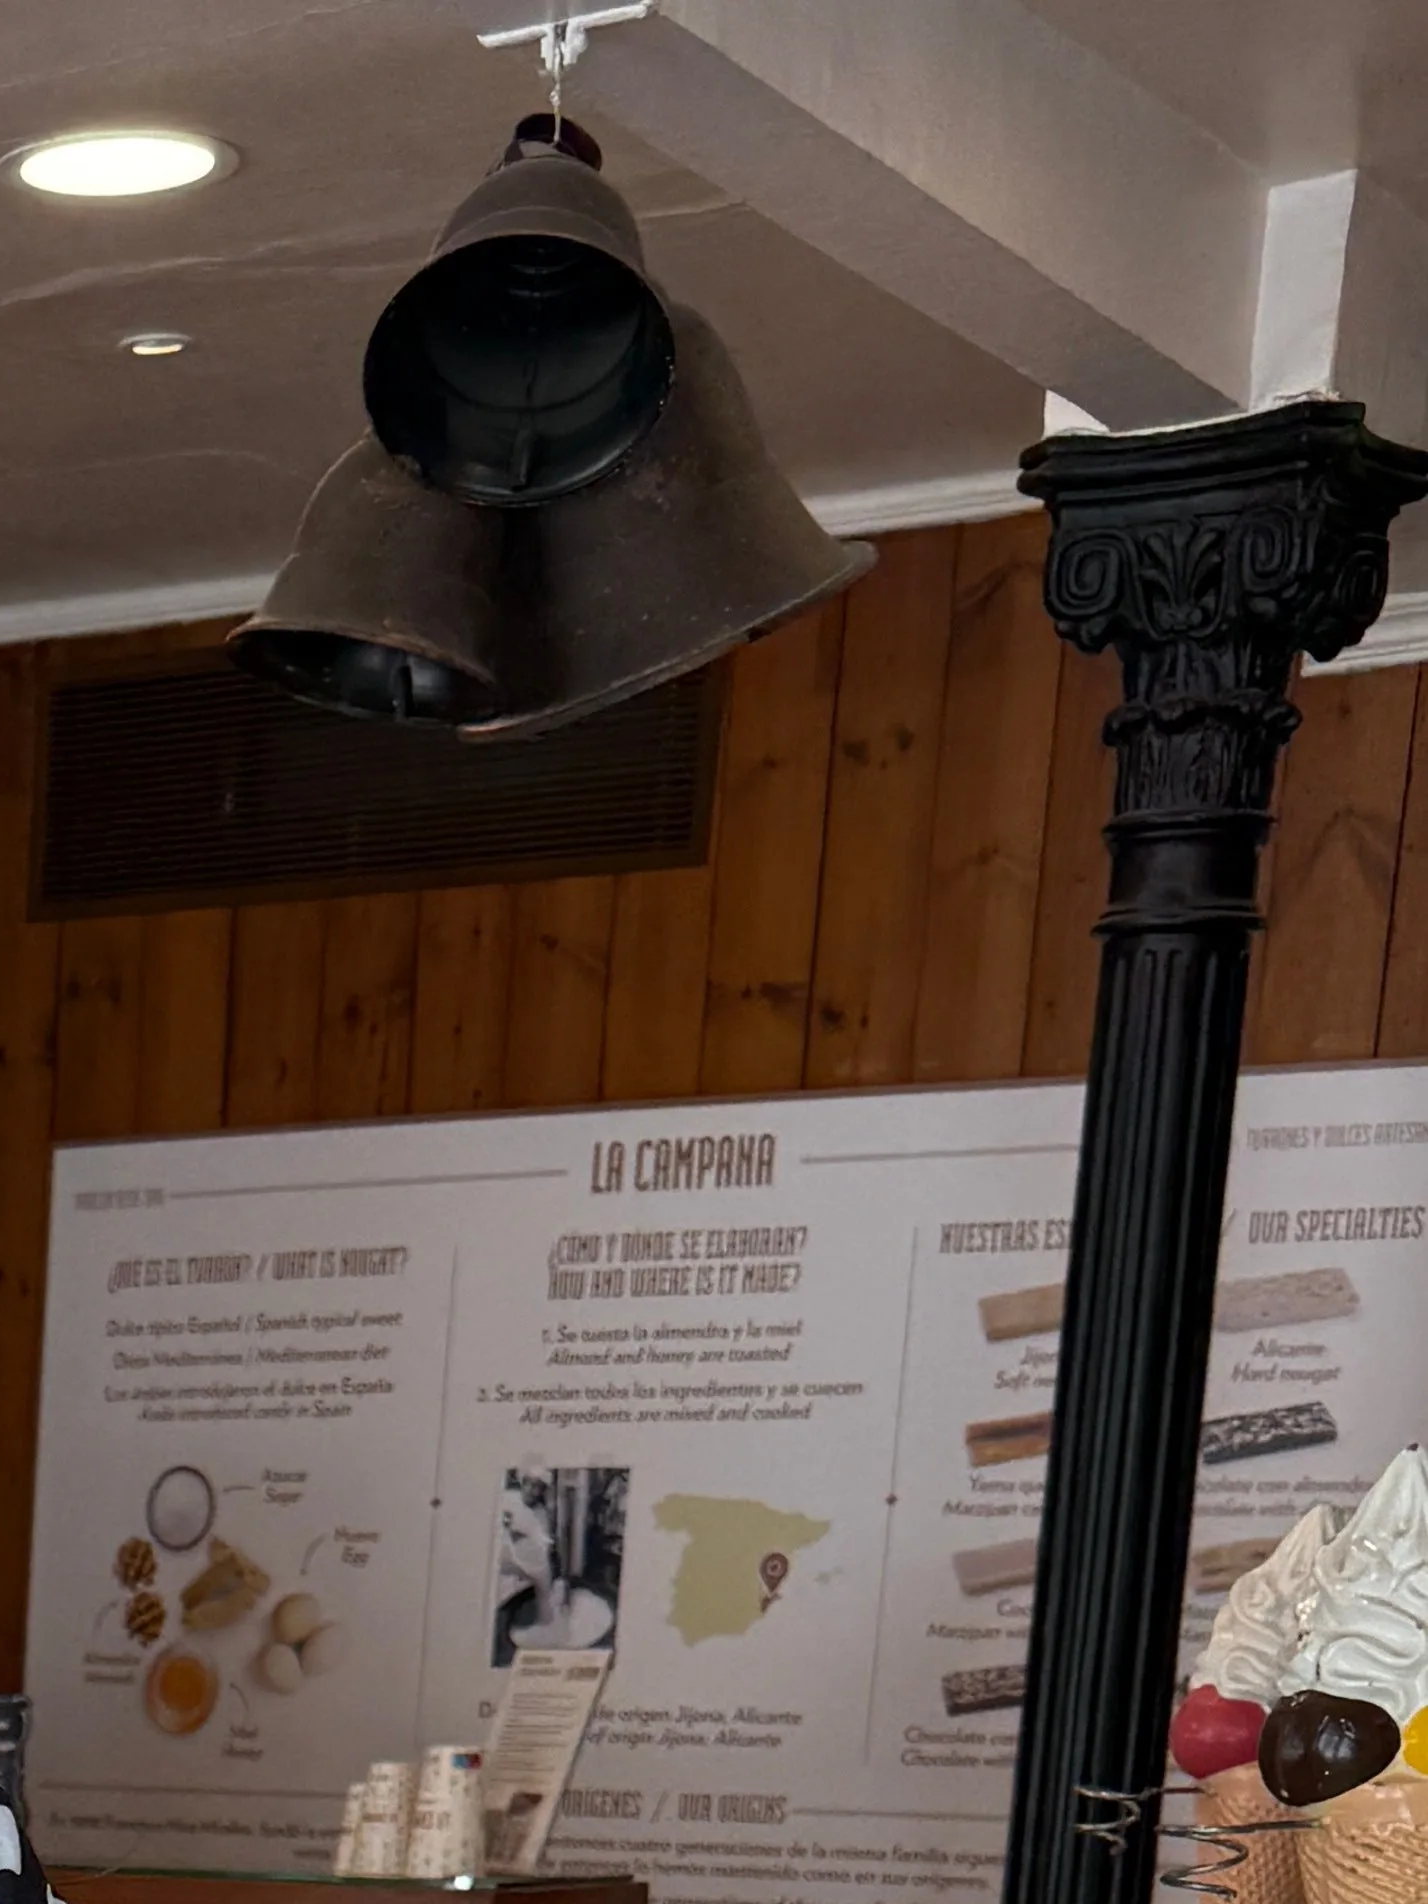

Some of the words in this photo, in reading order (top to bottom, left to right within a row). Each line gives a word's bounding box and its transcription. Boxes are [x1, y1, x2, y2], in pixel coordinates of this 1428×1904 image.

[590, 1140, 626, 1194] LA
[634, 1133, 776, 1193] CAMPANA
[605, 1232, 618, 1262] Y
[679, 1229, 704, 1260] SE
[939, 1220, 1039, 1254] NUESTRAS
[1043, 1219, 1074, 1251] ES
[1248, 1210, 1289, 1244] OUR
[1294, 1205, 1426, 1242] SPECIALTIES
[547, 1266, 586, 1300] HOW
[589, 1267, 626, 1299] AND
[630, 1265, 693, 1298] WHERE
[696, 1265, 715, 1296] IS
[717, 1263, 739, 1295] IT
